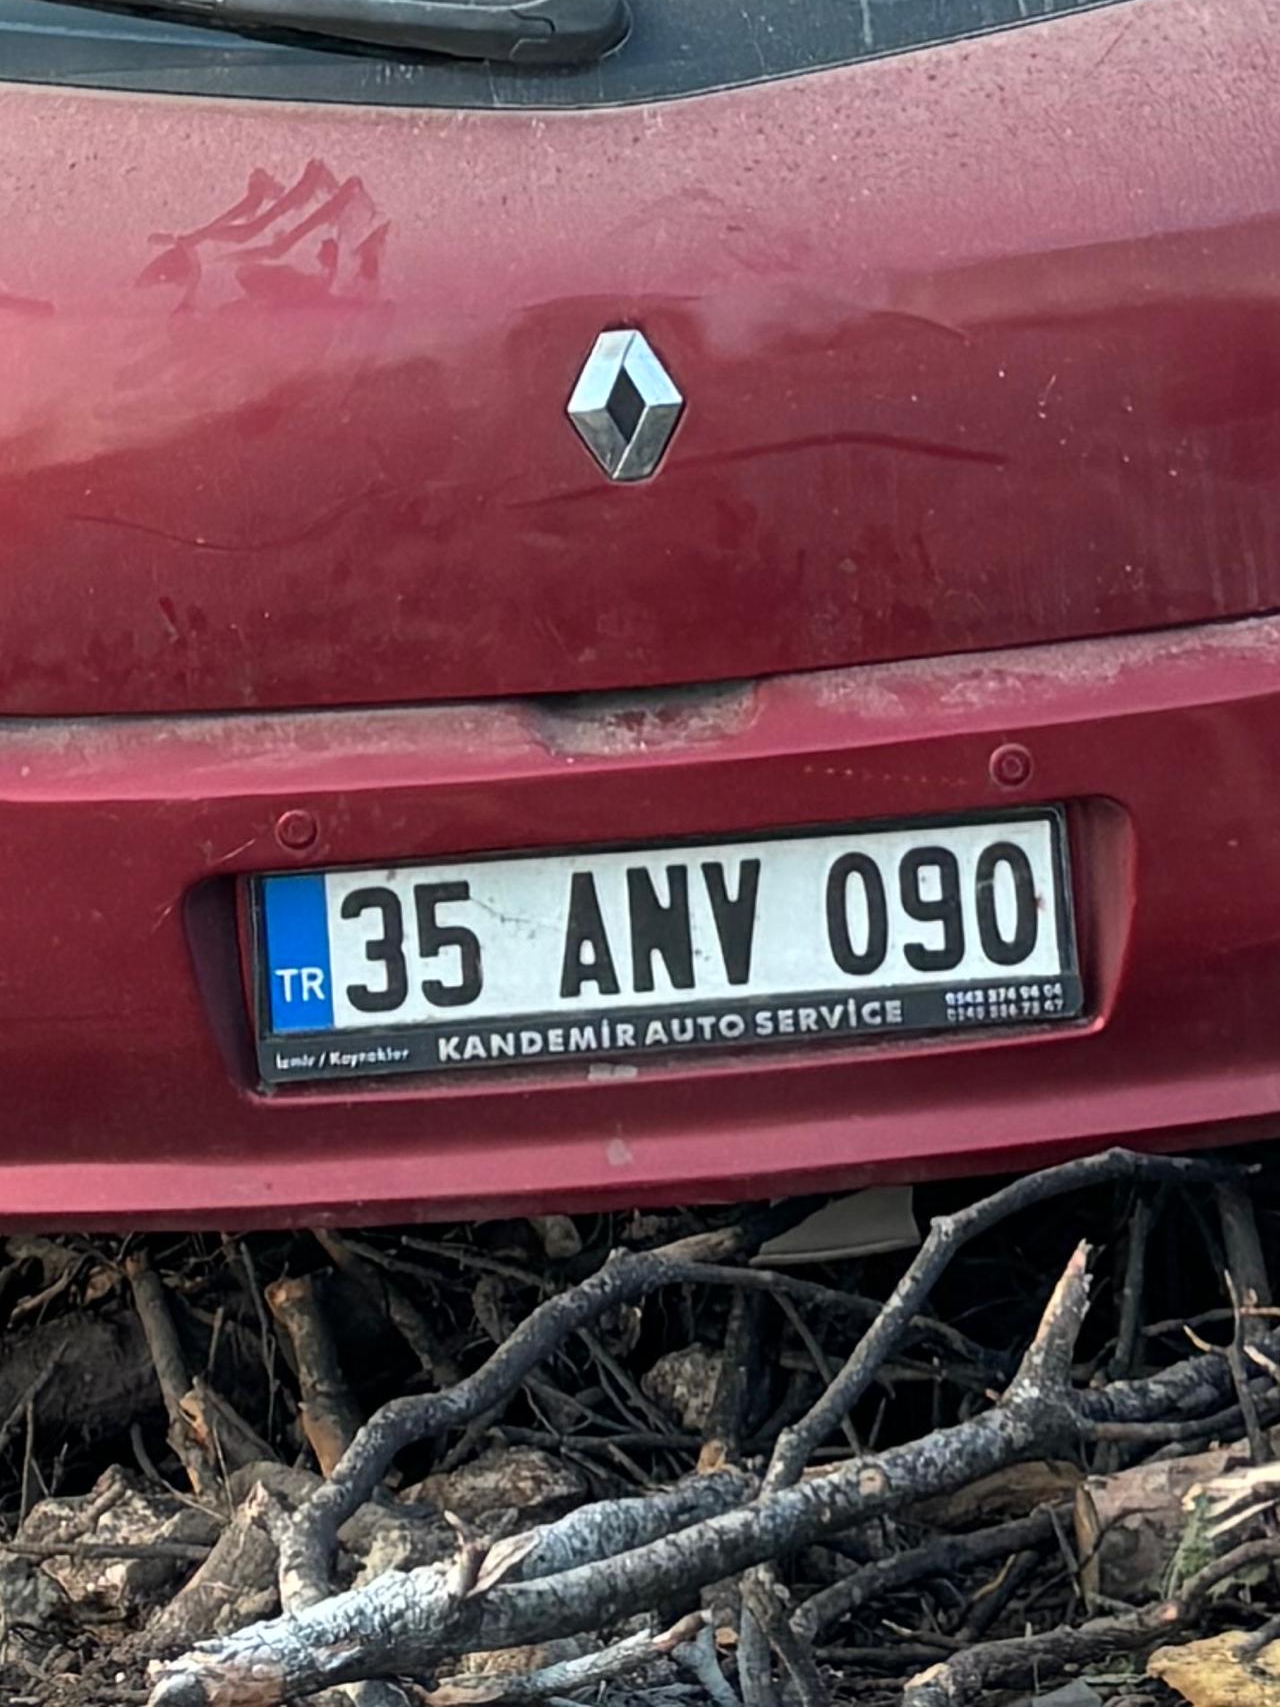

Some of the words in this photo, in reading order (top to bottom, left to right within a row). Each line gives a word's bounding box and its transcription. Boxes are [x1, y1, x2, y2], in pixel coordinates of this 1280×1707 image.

[340, 879, 484, 1013] 35
[559, 858, 762, 999] ANV
[825, 840, 1039, 976] 090
[274, 967, 325, 1003] TR
[437, 1018, 637, 1063] KANDEMİR
[644, 1012, 746, 1047] AUTO
